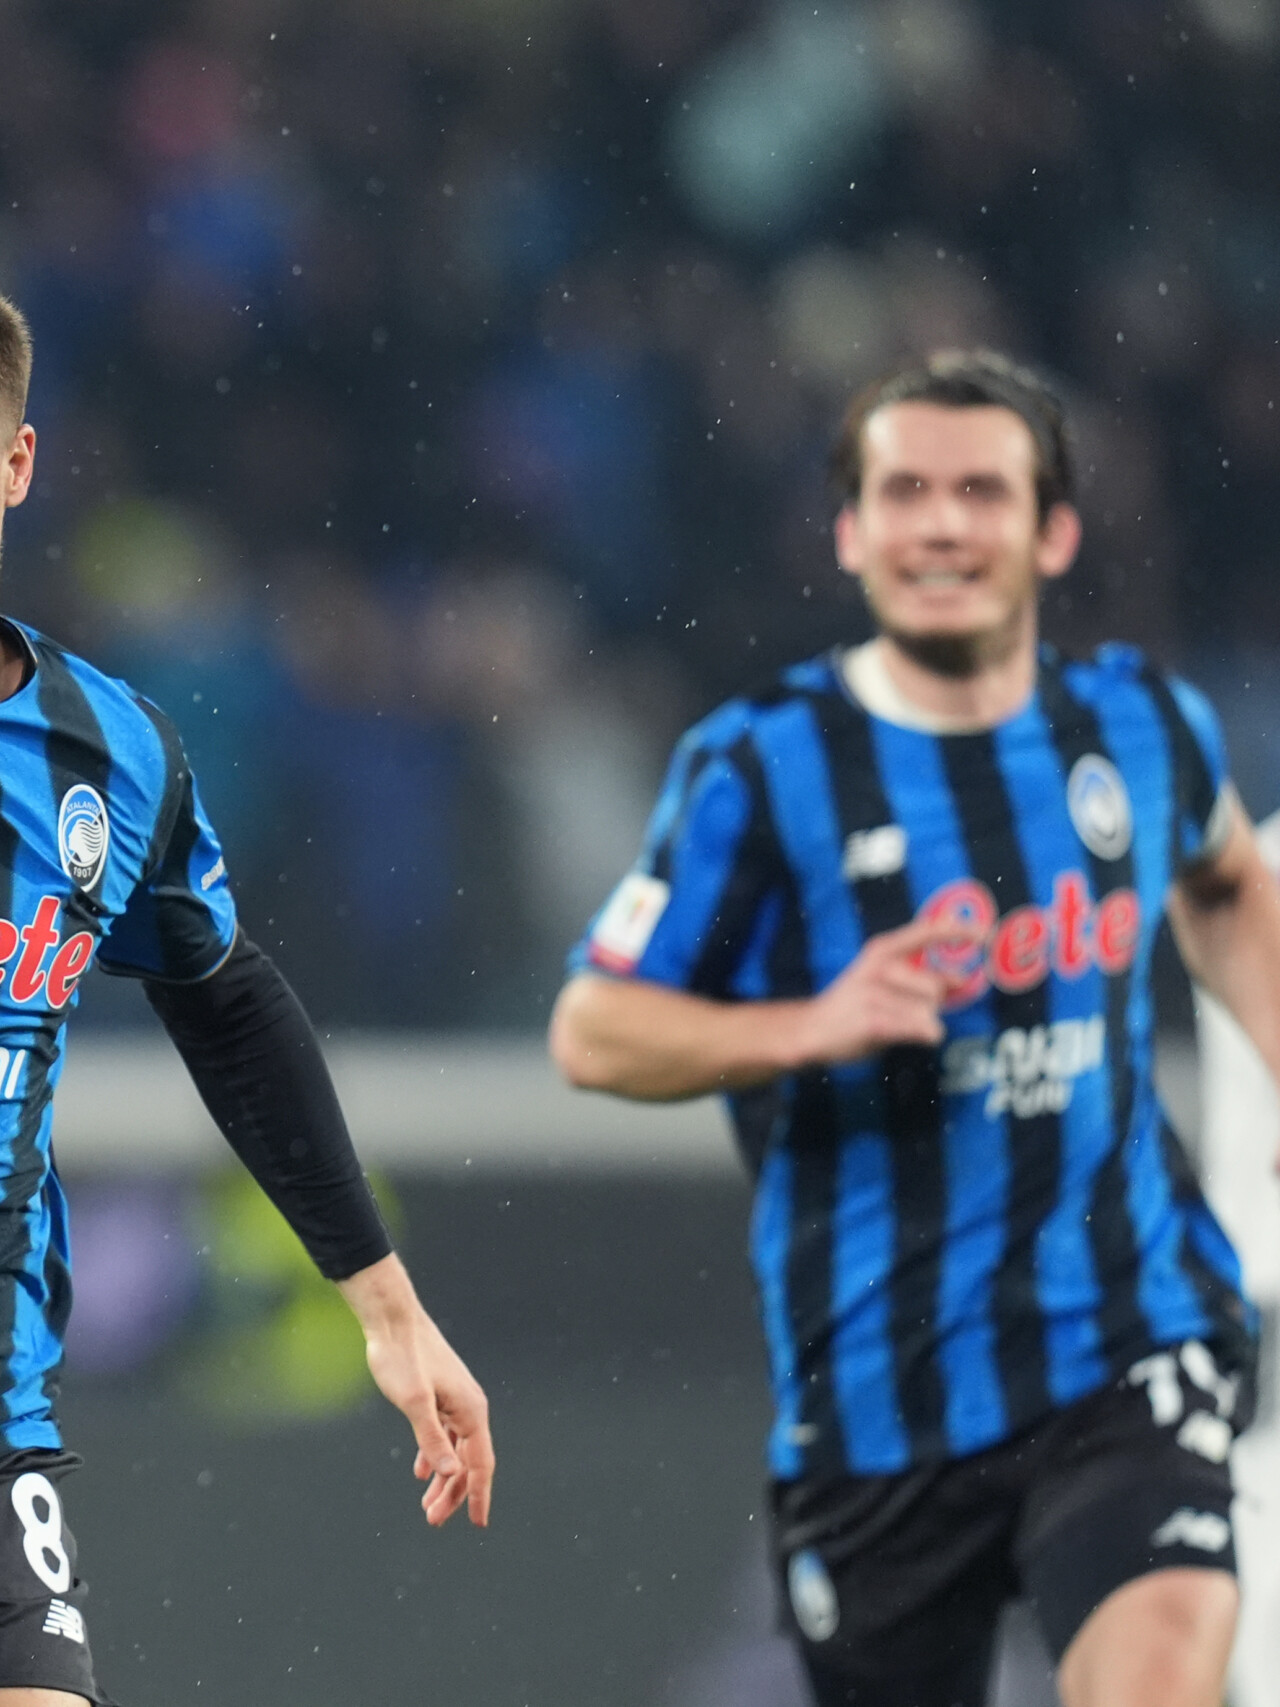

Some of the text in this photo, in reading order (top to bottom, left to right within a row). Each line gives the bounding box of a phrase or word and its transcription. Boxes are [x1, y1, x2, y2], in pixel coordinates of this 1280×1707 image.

[66, 800, 100, 814] ATALANTA
[73, 866, 93, 879] 1907
[11, 1472, 70, 1594] 8
